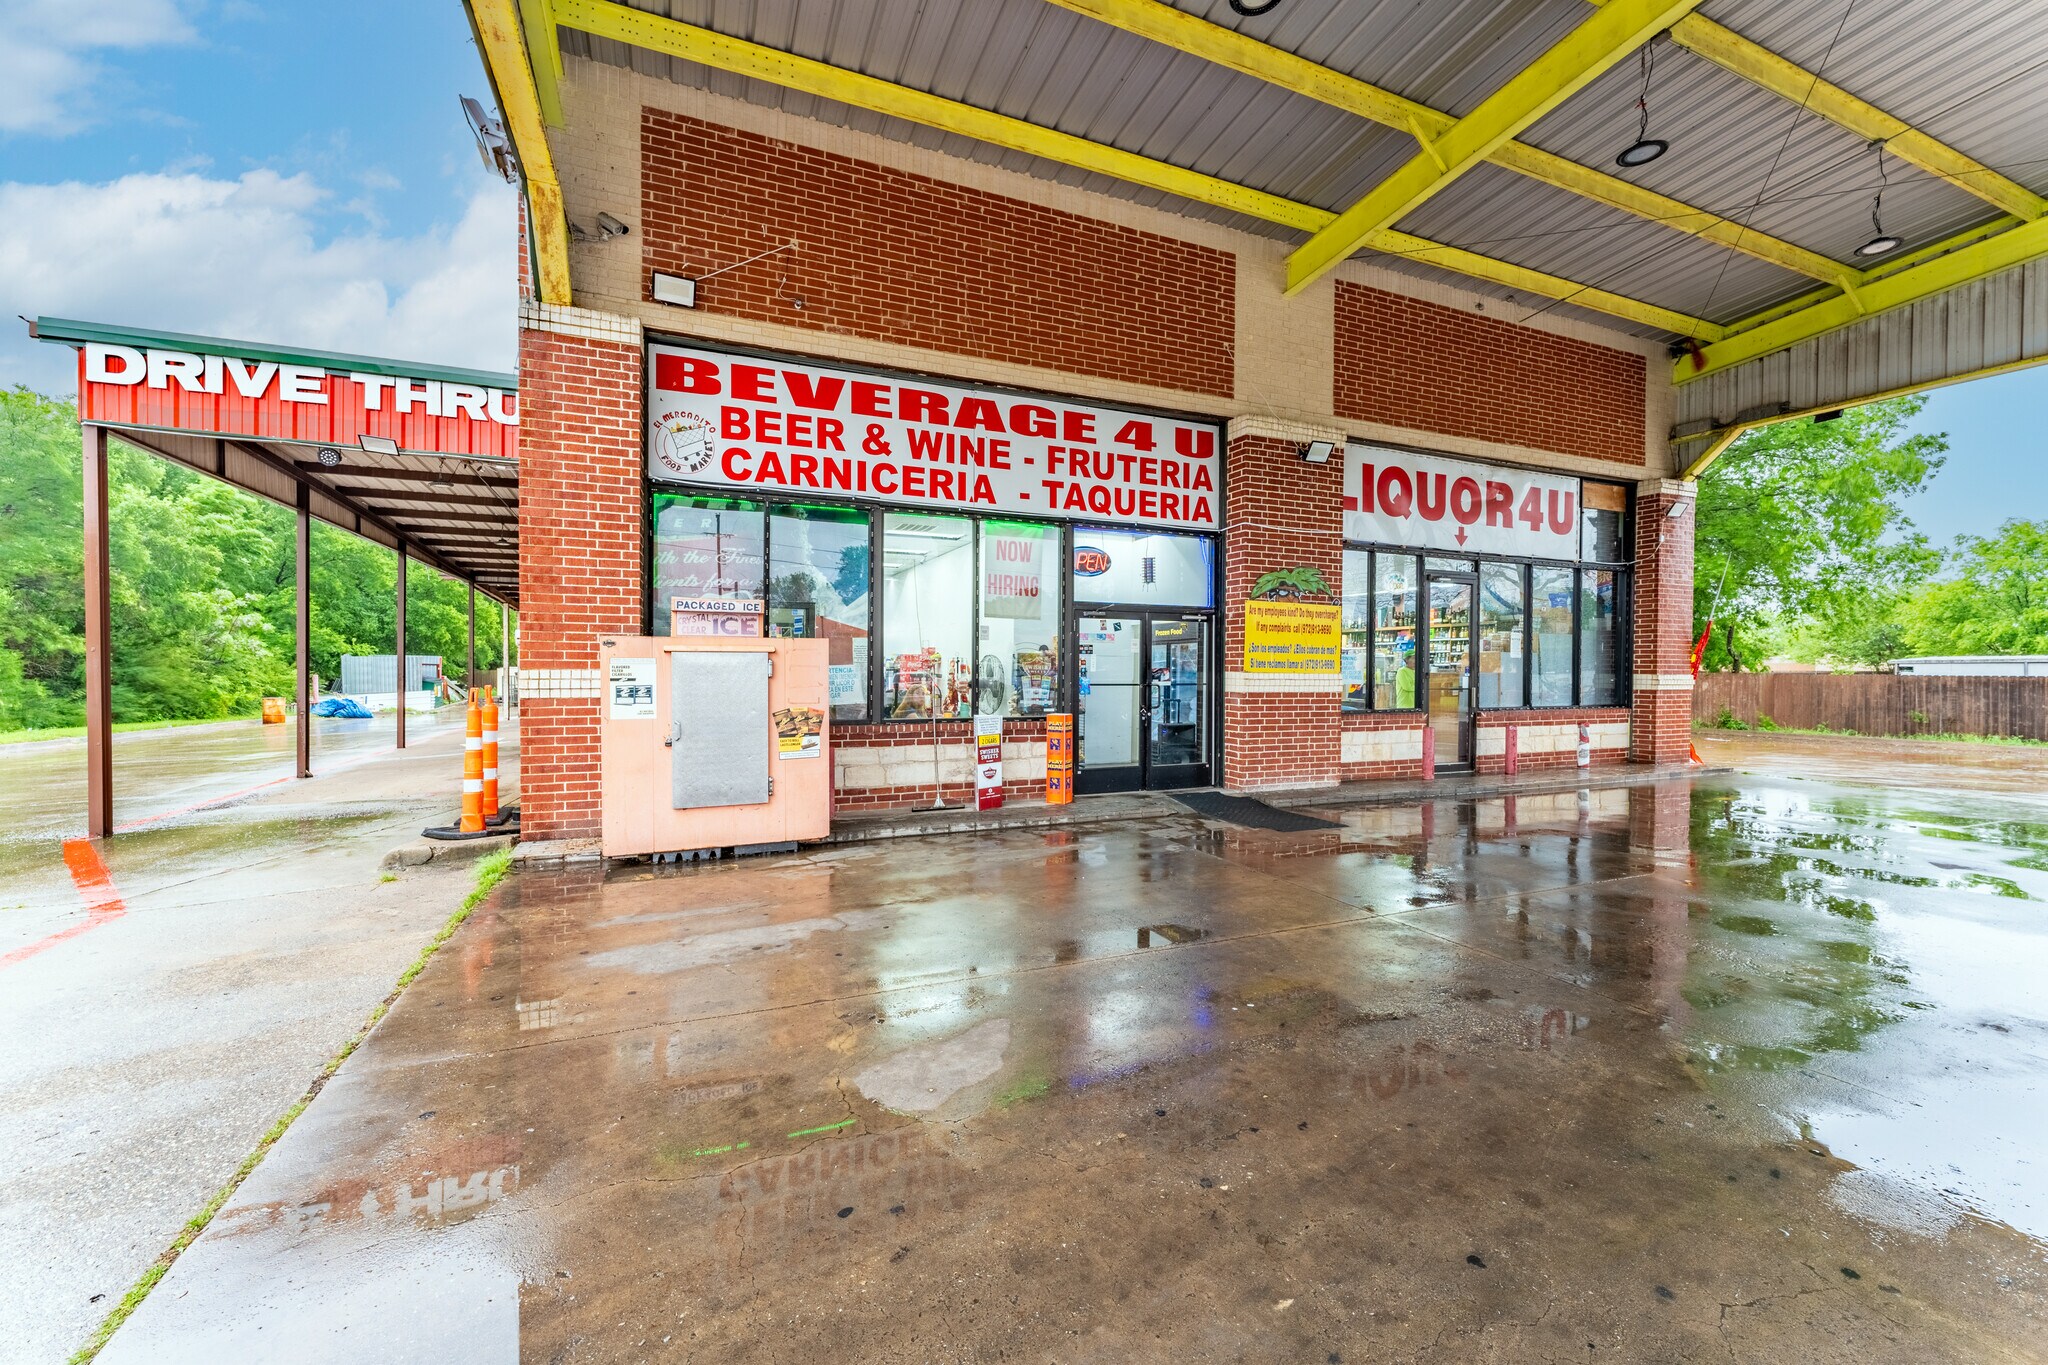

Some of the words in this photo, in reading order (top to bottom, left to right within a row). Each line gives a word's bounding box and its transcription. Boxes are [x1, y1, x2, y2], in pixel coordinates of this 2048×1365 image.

[86, 342, 328, 404] DRIVE
[350, 372, 519, 425] THRU
[656, 353, 1097, 444] BEVERAGE
[1114, 420, 1157, 451] 4
[1175, 427, 1214, 458] U
[653, 420, 663, 429] EL
[661, 455, 682, 471] FOOD
[690, 440, 713, 472] MARKET
[721, 405, 846, 452] BEER
[862, 423, 892, 456] &
[907, 428, 1011, 470] WINE
[1047, 445, 1213, 492] FRUTERIA
[721, 447, 997, 505] CARNICERIA
[1042, 480, 1213, 523] TAQUERIA
[996, 540, 1032, 562] NOW
[1075, 552, 1108, 572] PEN
[988, 574, 1039, 597] HIRING
[676, 601, 736, 611] PACKAGED
[743, 603, 760, 612] ICE
[1257, 607, 1264, 618] my
[1265, 606, 1287, 618] employees
[1288, 607, 1298, 617] kind?
[1299, 608, 1304, 618] Do
[1305, 608, 1314, 620] they
[1315, 609, 1338, 621] overcharge?
[678, 614, 711, 625] CRYSTAL
[712, 614, 758, 635] ICE
[1256, 621, 1260, 631] If
[1260, 623, 1268, 634] any
[1269, 622, 1291, 634] complaints
[1155, 629, 1170, 637] Frozen
[1268, 644, 1292, 655] empleados?
[1307, 645, 1320, 654] cobran
[1321, 645, 1325, 654] de
[1267, 659, 1286, 668] reclamos
